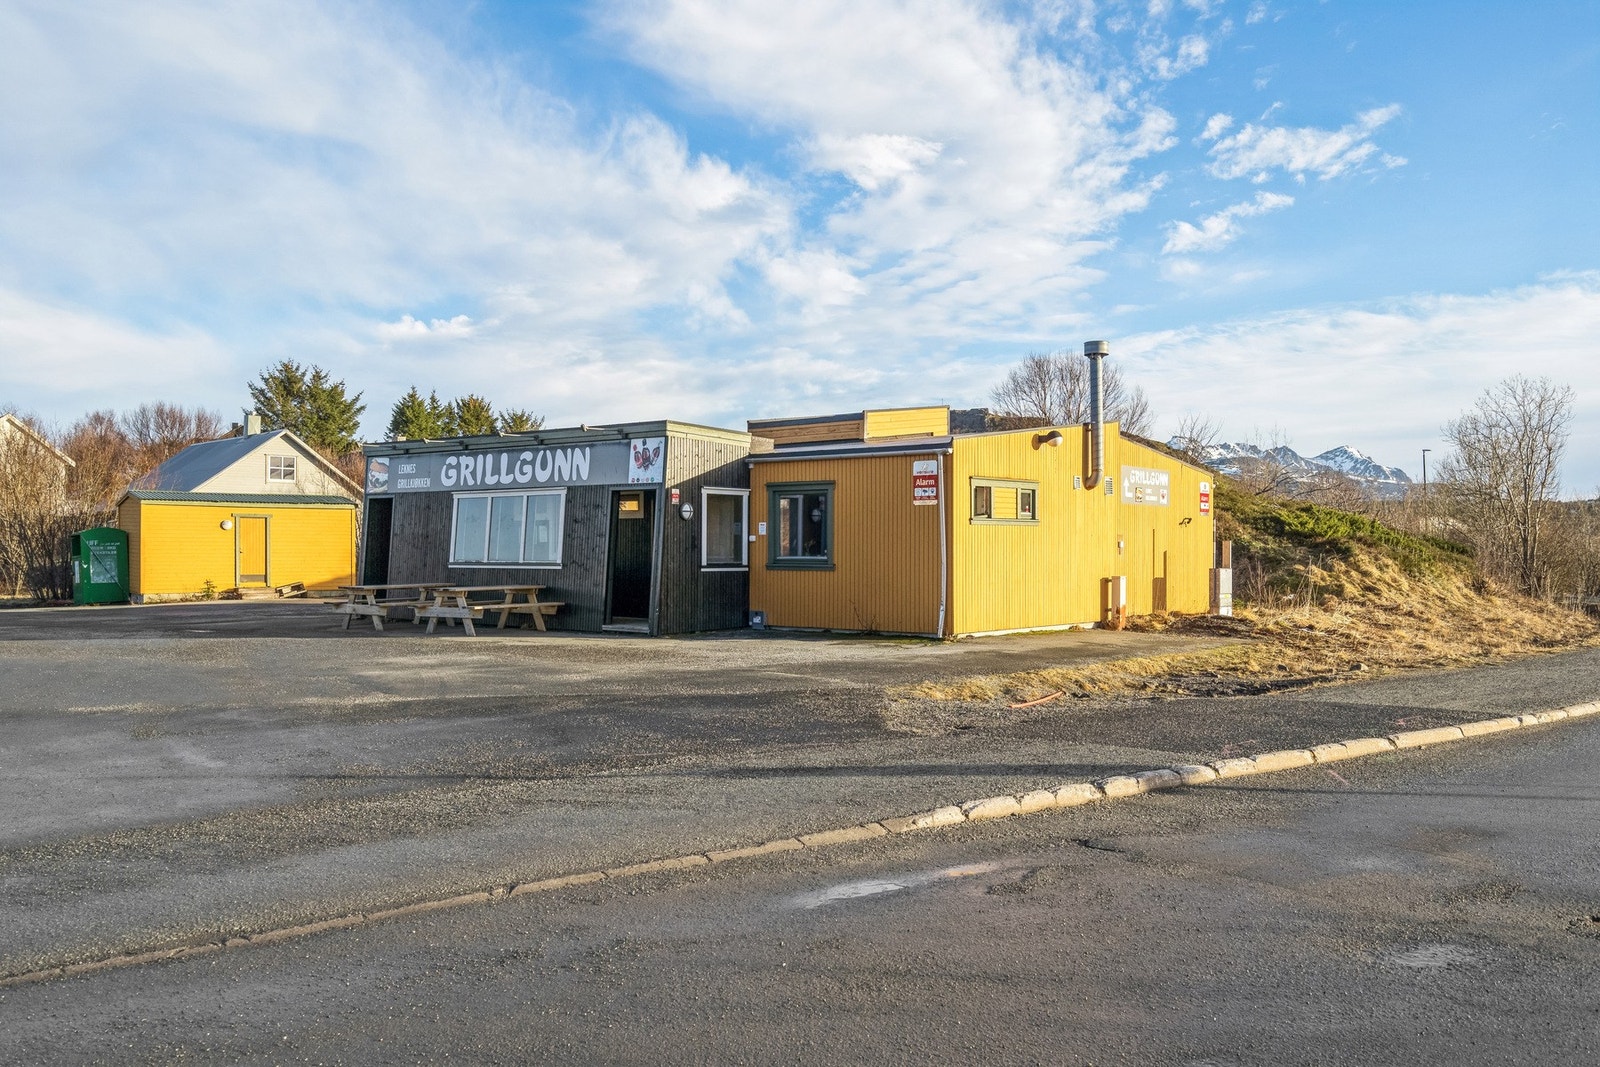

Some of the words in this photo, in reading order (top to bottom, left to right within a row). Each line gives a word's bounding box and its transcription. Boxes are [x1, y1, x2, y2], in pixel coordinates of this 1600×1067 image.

[398, 463, 417, 475] LEKNES
[440, 447, 591, 487] GRILLGUNN
[915, 478, 935, 486] Alarm
